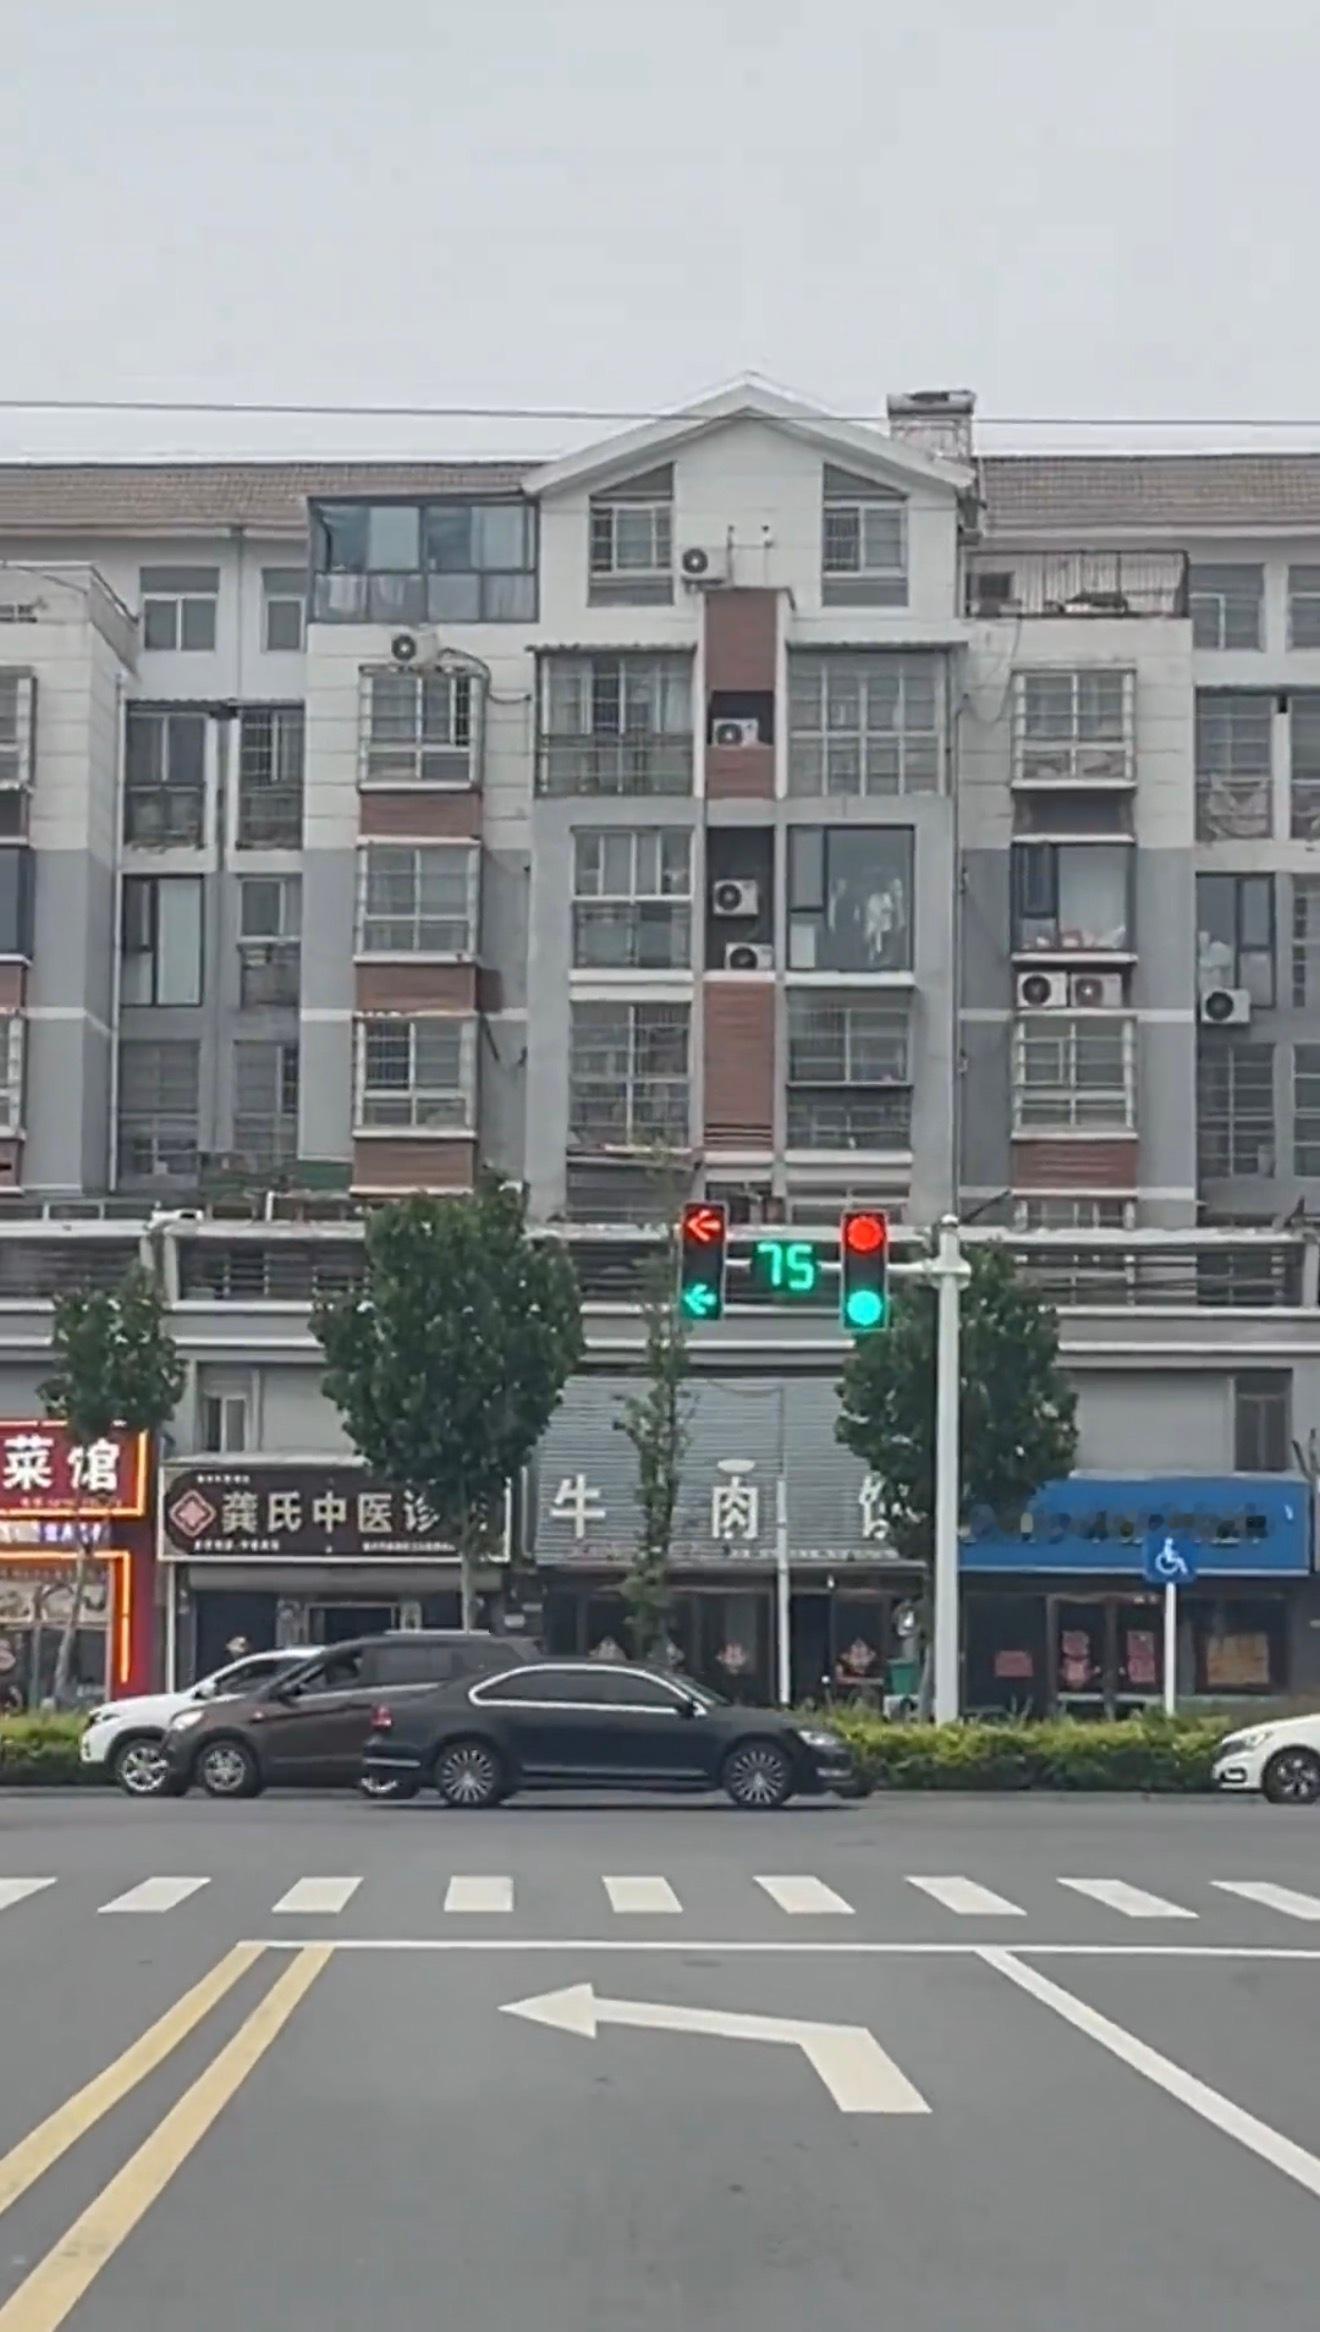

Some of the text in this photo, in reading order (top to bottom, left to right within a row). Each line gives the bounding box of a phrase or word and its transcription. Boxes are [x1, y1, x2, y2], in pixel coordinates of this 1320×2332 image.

[757, 1242, 815, 1291] 75
[3, 1435, 120, 1491] 菜馆
[222, 1490, 488, 1534] 龚氏中医诊
